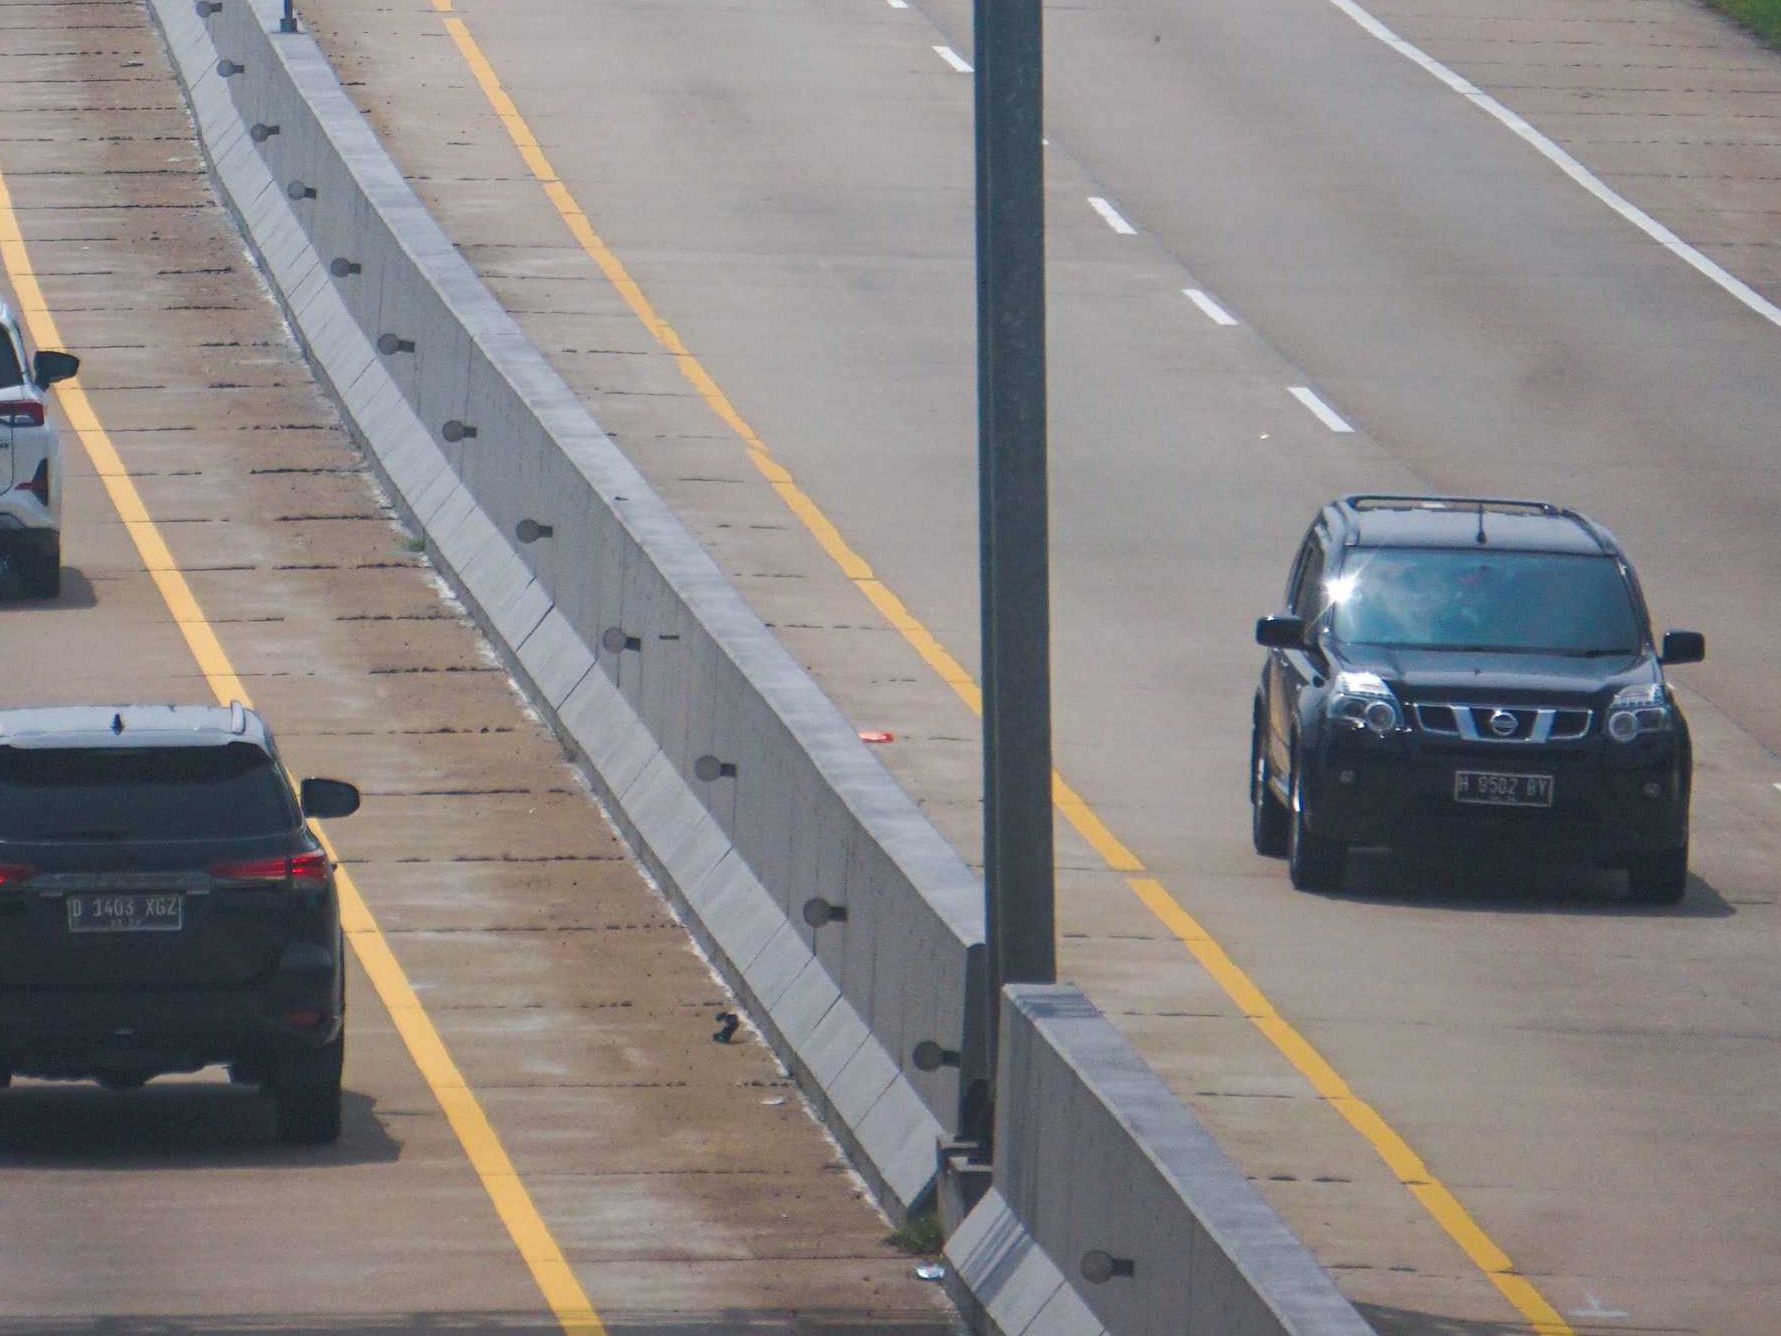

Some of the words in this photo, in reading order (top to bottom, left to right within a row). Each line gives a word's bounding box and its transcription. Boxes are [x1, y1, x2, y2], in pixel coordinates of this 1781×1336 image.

[1460, 775, 1469, 791] H
[1479, 776, 1517, 795] 9502
[73, 899, 82, 917] D
[93, 899, 134, 917] 1403
[146, 897, 177, 916] XGZ
